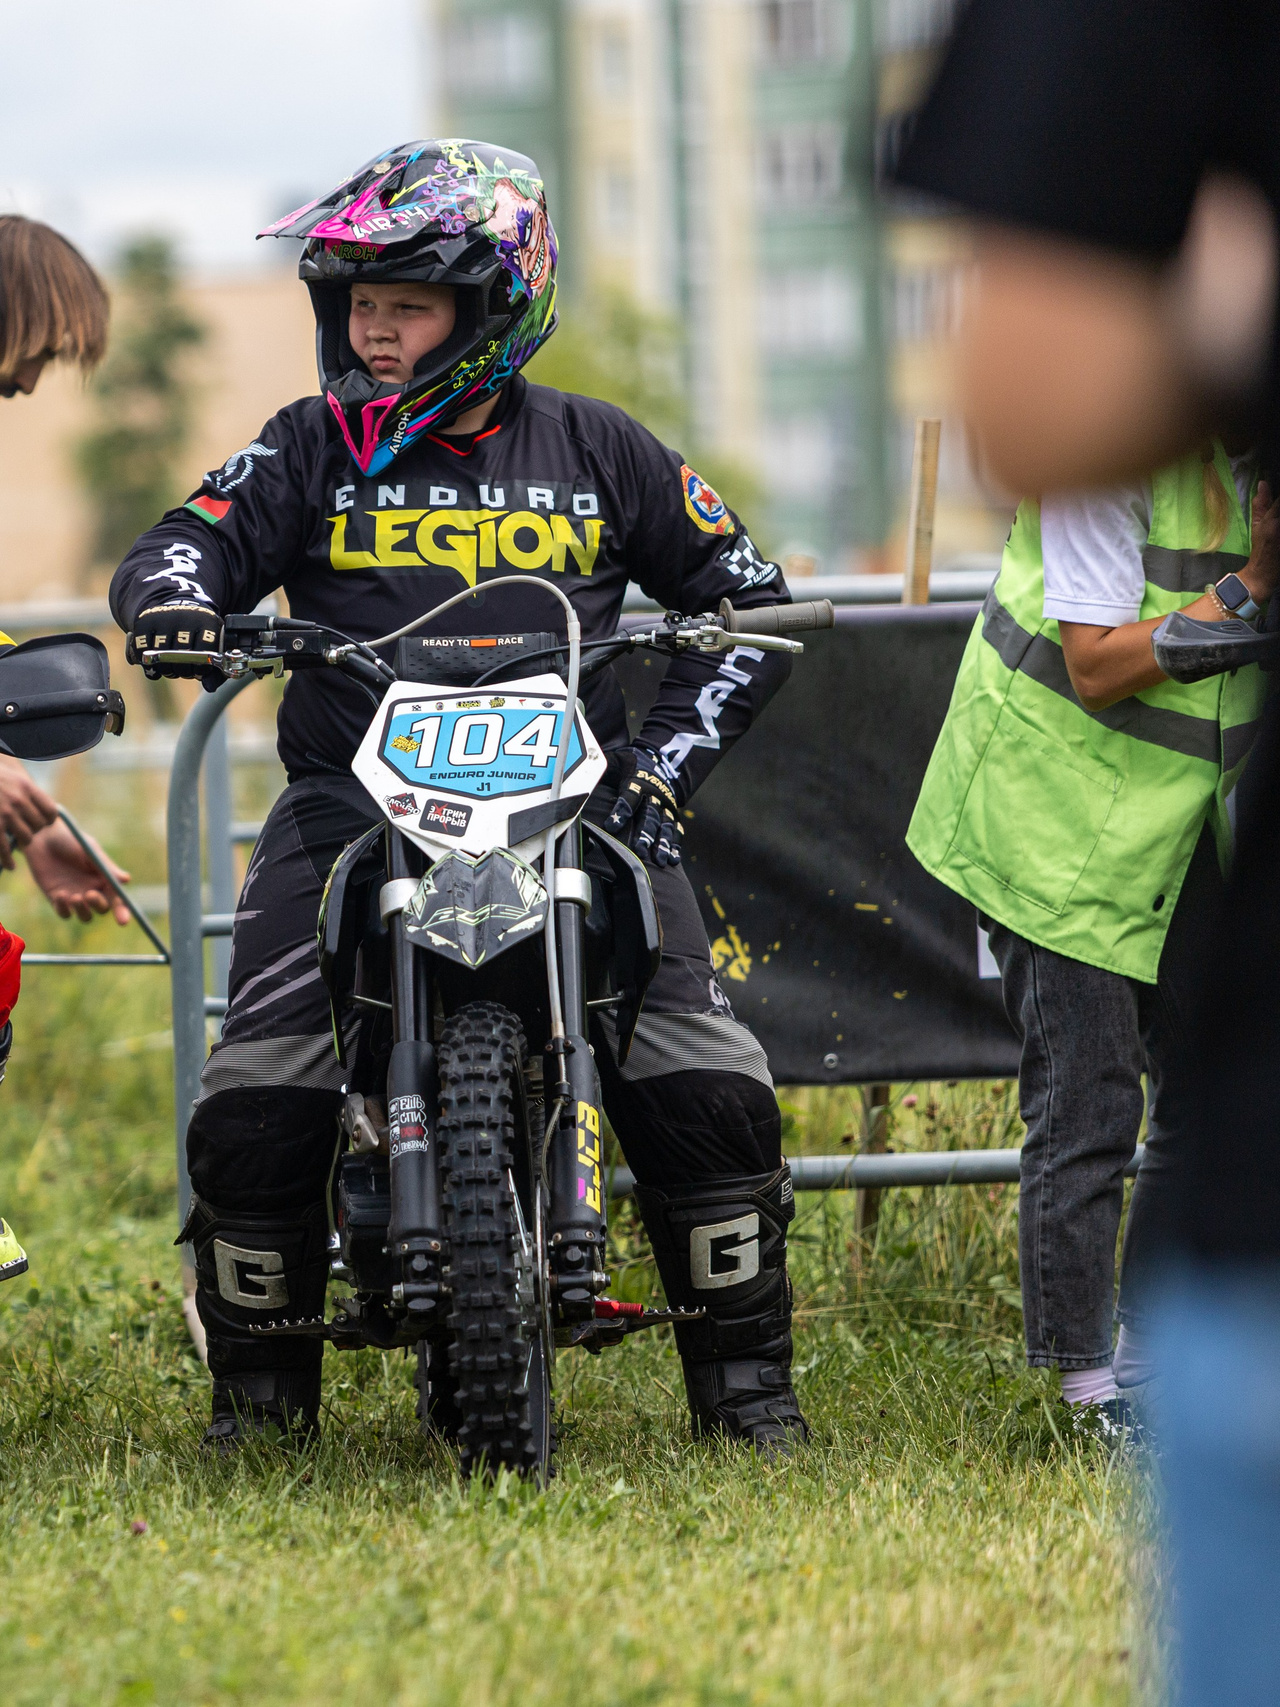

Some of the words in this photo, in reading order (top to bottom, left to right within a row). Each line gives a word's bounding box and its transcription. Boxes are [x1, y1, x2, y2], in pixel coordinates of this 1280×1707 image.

[327, 244, 377, 260] AIROH
[388, 411, 412, 455] AIROH
[335, 484, 599, 516] ENDURO
[326, 509, 606, 590] LEGION
[422, 639, 453, 647] READY
[456, 639, 470, 647] TO
[497, 636, 523, 646] RACE
[409, 713, 560, 768] 104
[429, 770, 485, 780] ENDURO
[487, 771, 536, 781] JUNIOR
[476, 781, 491, 792] J1
[426, 812, 467, 828] ПРОРЫВ
[400, 1097, 423, 1110] ЕШЬ
[400, 1111, 422, 1124] СПИ
[401, 1140, 425, 1151] ПОВТОРИ
[689, 1212, 759, 1290] G
[213, 1239, 290, 1310] G
